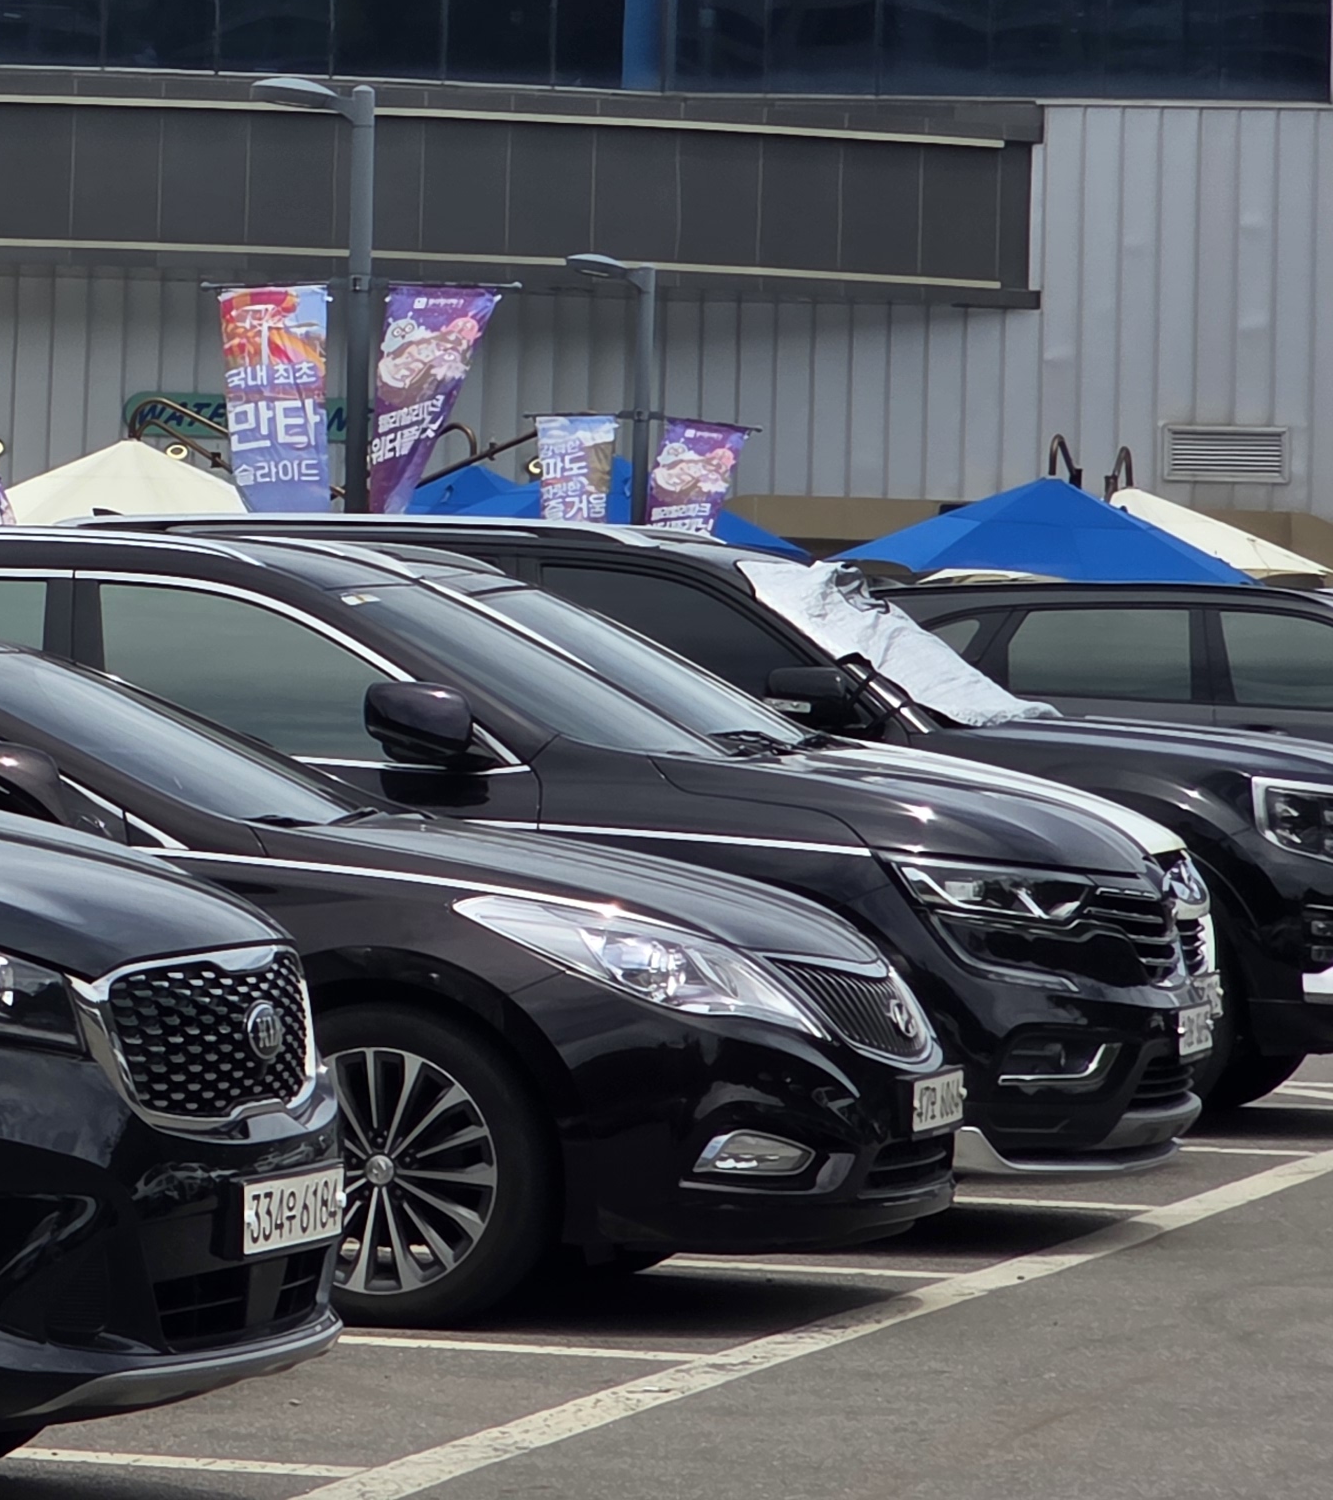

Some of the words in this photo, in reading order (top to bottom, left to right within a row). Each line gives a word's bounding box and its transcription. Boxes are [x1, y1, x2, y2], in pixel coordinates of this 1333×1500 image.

[224, 365, 268, 389] 국내
[273, 361, 318, 386] 최초
[226, 397, 321, 452] 만타
[234, 458, 321, 486] 슬라이드
[540, 451, 589, 481] 파도
